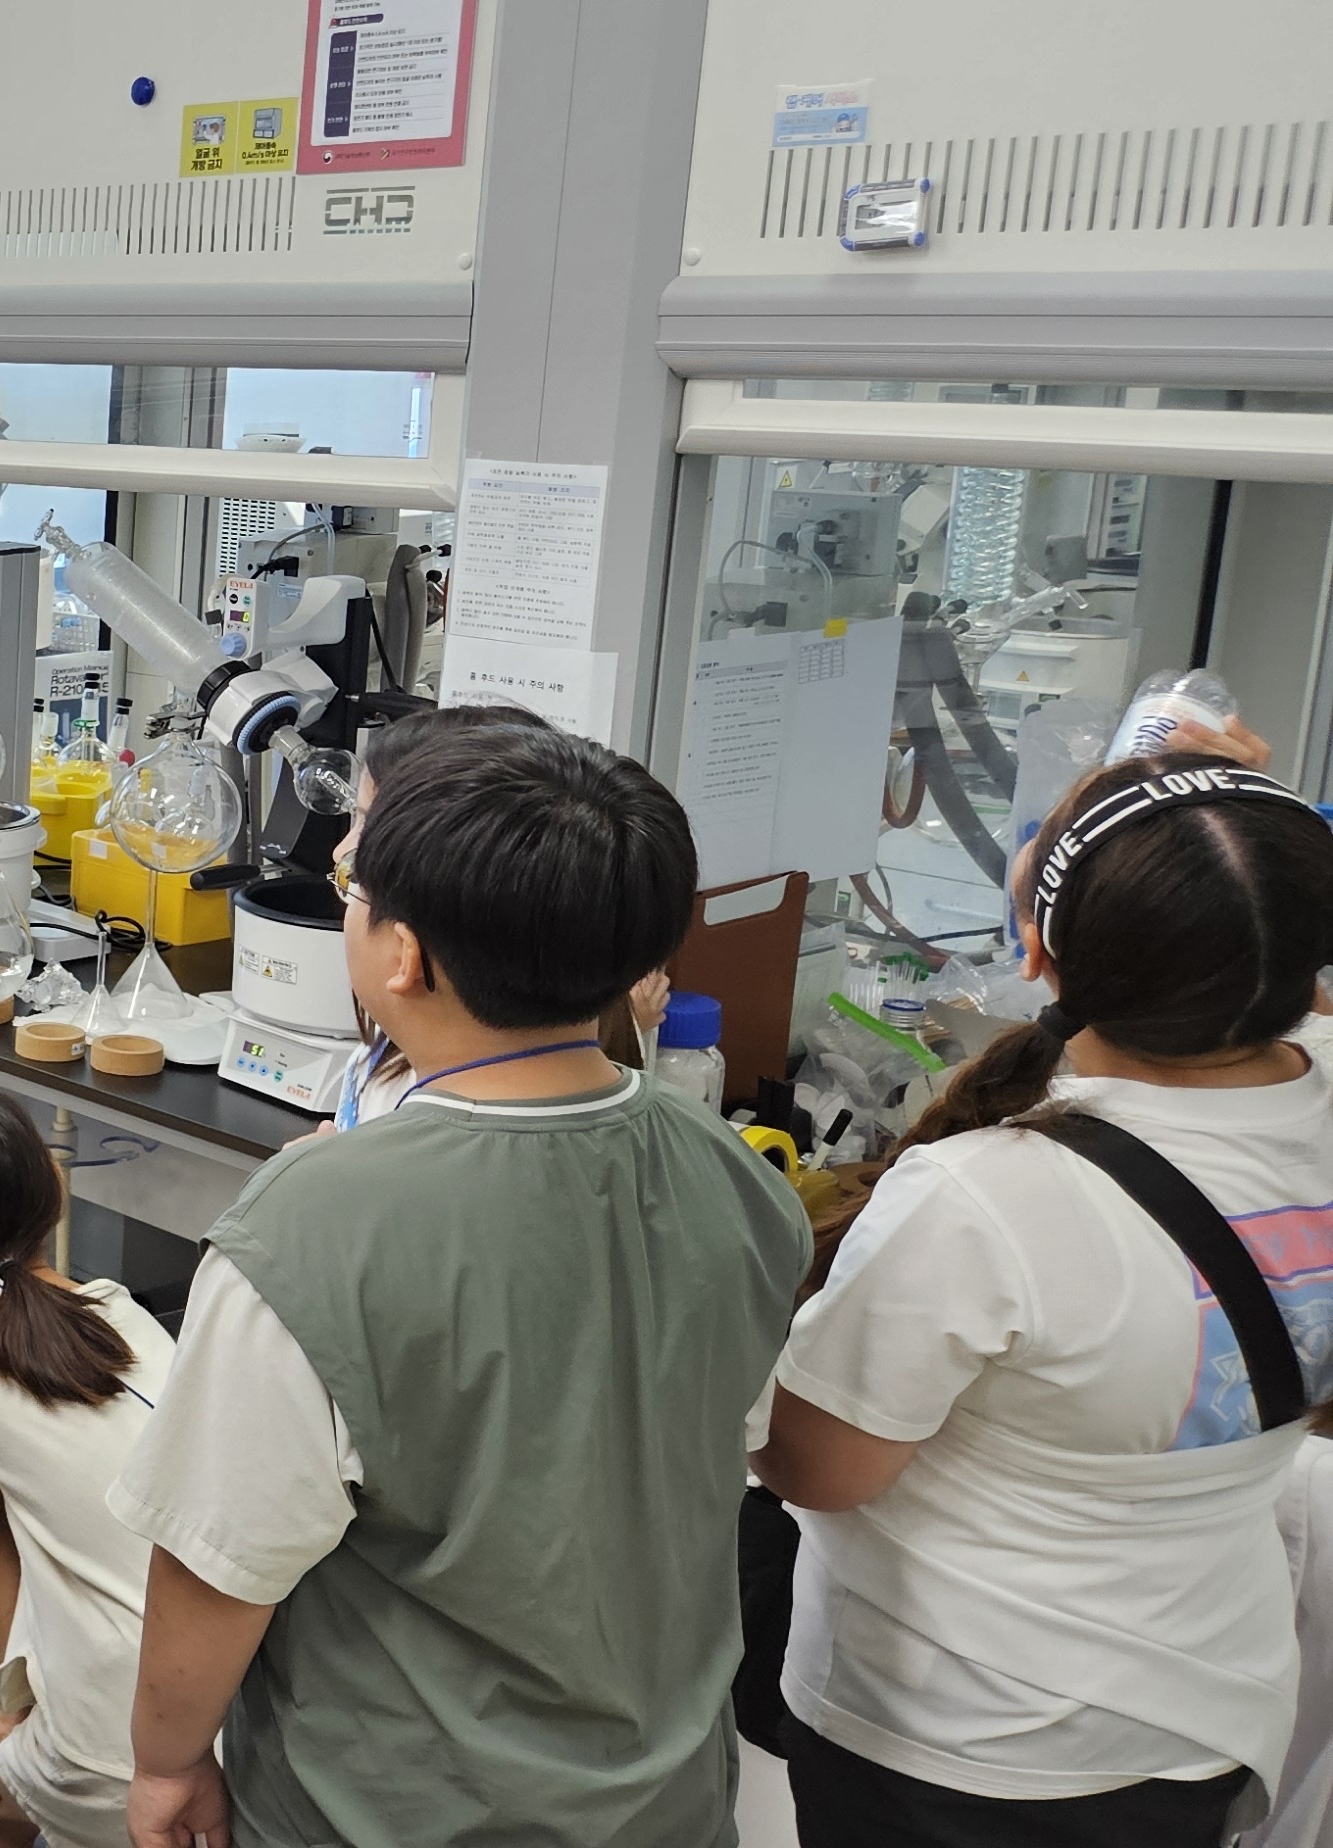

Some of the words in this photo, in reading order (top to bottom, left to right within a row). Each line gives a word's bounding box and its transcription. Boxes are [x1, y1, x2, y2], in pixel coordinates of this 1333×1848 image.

[207, 159, 222, 170] 금지
[229, 581, 253, 589] EYELA
[52, 667, 82, 675] Operation
[51, 673, 109, 685] Rotavar
[499, 676, 514, 686] 사용
[518, 678, 525, 687] 시
[529, 680, 545, 690] 주의
[548, 683, 564, 693] 사항
[1141, 769, 1235, 801] LOVE
[1038, 831, 1082, 905] LOVE
[287, 1085, 312, 1100] EYELA
